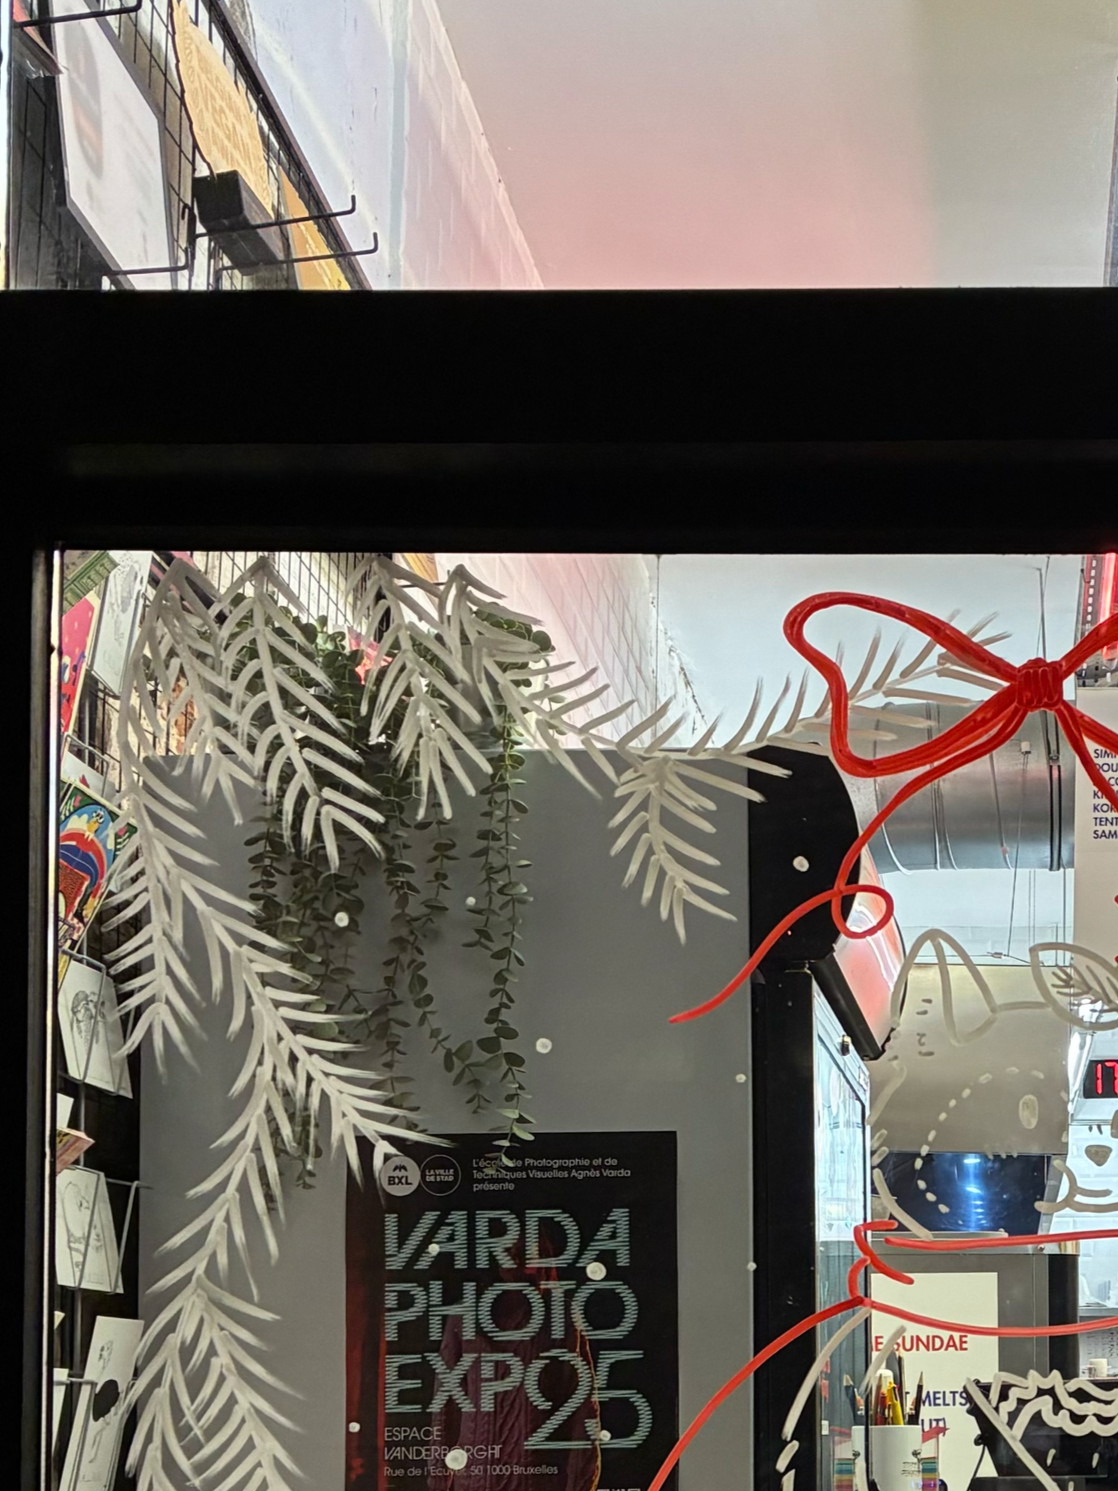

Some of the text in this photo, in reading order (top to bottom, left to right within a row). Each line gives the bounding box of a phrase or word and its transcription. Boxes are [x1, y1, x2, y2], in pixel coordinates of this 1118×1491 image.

[525, 1157, 617, 1168] Photographie et de
[528, 1169, 568, 1178] Visuelles
[570, 1168, 600, 1178] Agnès
[602, 1168, 631, 1177] Varda
[387, 1176, 413, 1186] BXL
[473, 1181, 515, 1192] présente
[384, 1208, 630, 1270] VARDA
[384, 1280, 639, 1341] PHOTO
[384, 1426, 442, 1441] ESPACE
[384, 1465, 558, 1476] Rue de 1000 Bruxelles
